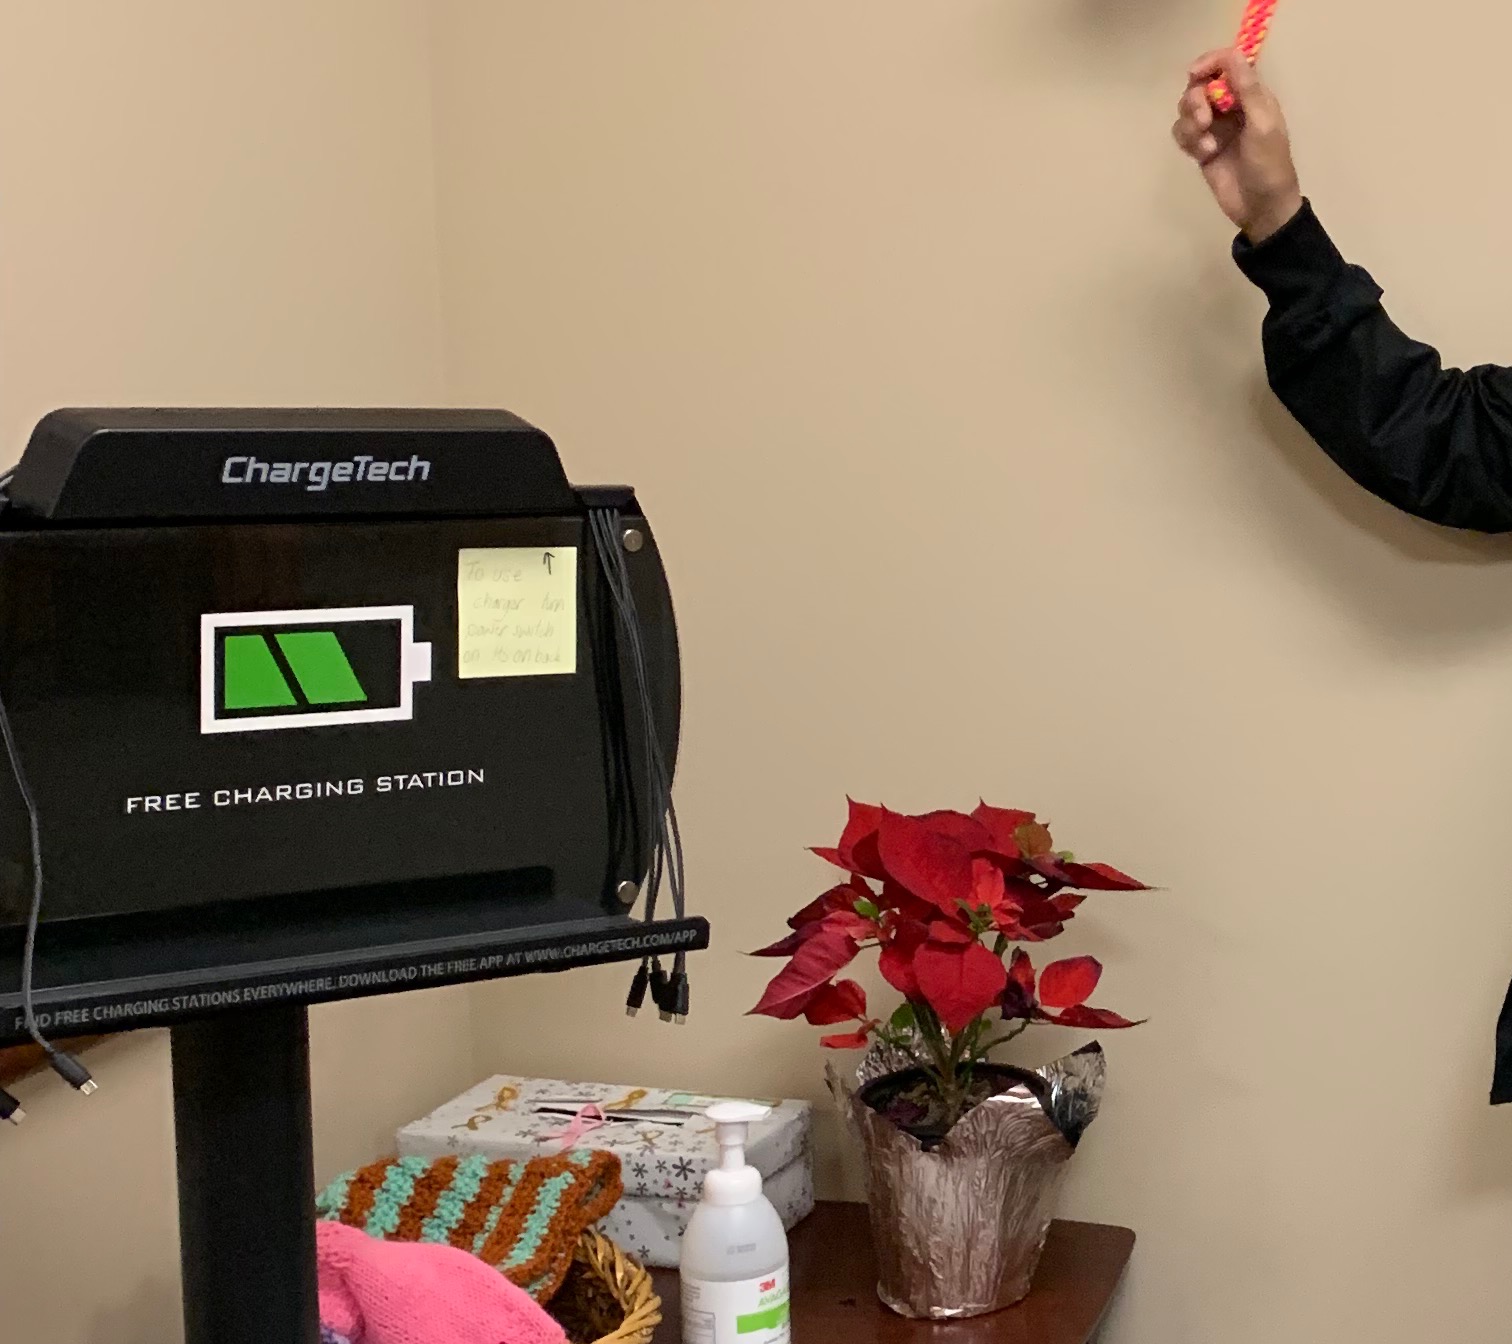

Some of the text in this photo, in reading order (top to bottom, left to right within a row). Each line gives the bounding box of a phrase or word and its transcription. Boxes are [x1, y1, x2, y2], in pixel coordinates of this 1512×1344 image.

[221, 454, 431, 492] ChargeTech
[464, 560, 523, 583] To use
[125, 768, 485, 814] FREE CHARGING STATION
[54, 1007, 90, 1027] FREE
[93, 997, 170, 1021] CHARGING
[172, 987, 241, 1011] STATIONS
[338, 966, 418, 989] DOWNLOAD
[420, 962, 444, 977] THE
[446, 957, 477, 974] FREE
[479, 954, 503, 970] APP
[506, 951, 522, 966] AT
[524, 928, 698, 963] WWW.CHARGETECH.COM/APP
[758, 1278, 776, 1293] 3M
